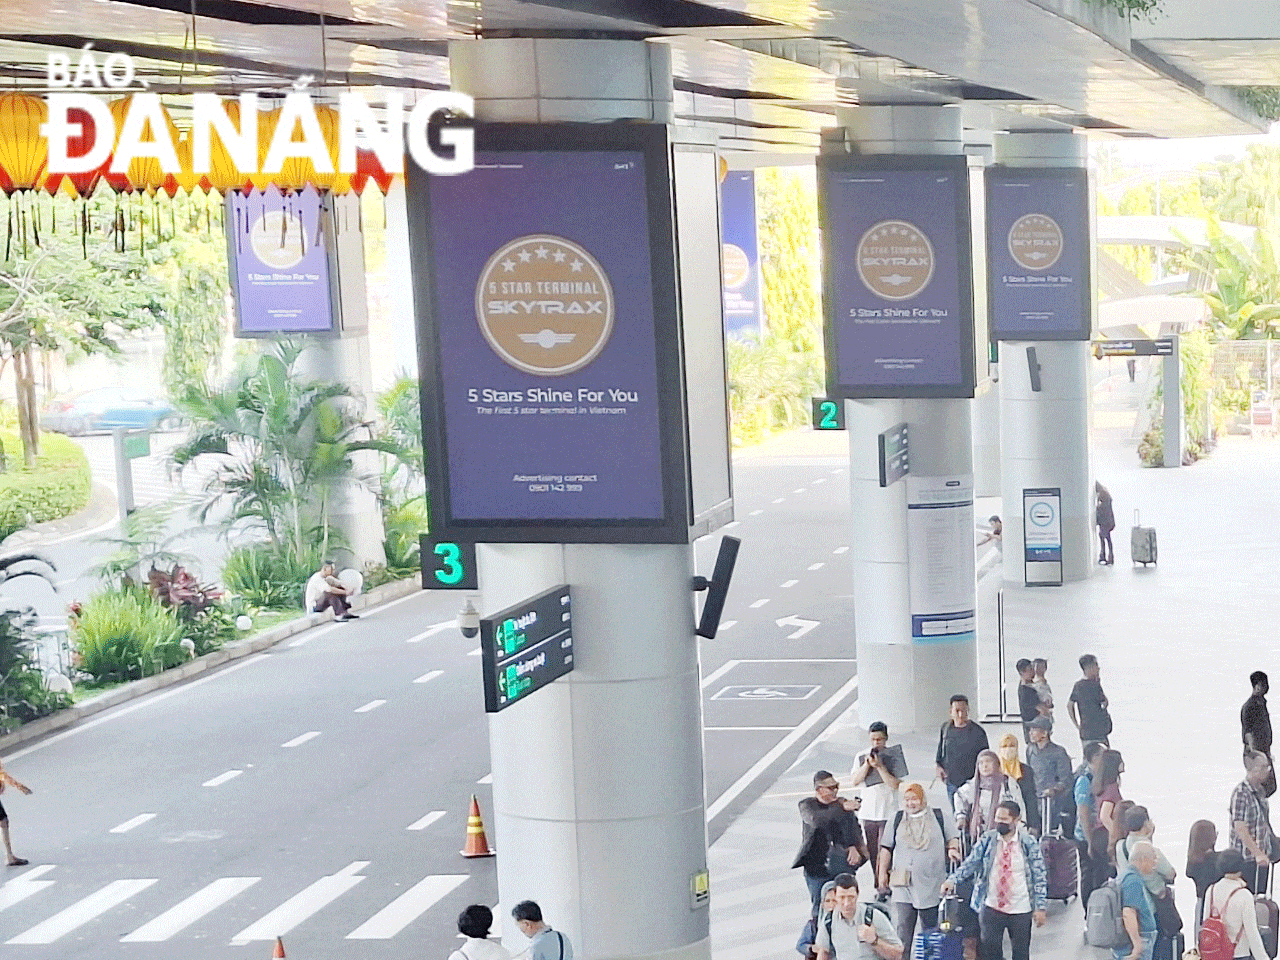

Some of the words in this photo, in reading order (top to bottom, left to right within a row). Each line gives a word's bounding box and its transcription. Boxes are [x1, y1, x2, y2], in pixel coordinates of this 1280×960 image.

[502, 282, 532, 294] STAR
[536, 282, 599, 294] TERMINAL
[487, 300, 603, 314] SKYTRAX
[913, 308, 929, 317] For
[931, 308, 948, 317] You
[468, 388, 478, 403] 5
[482, 388, 523, 403] Stars
[527, 387, 573, 403] Shine
[578, 388, 605, 403] For
[608, 388, 639, 403] You
[820, 401, 838, 428] 2
[434, 542, 464, 584] 3
